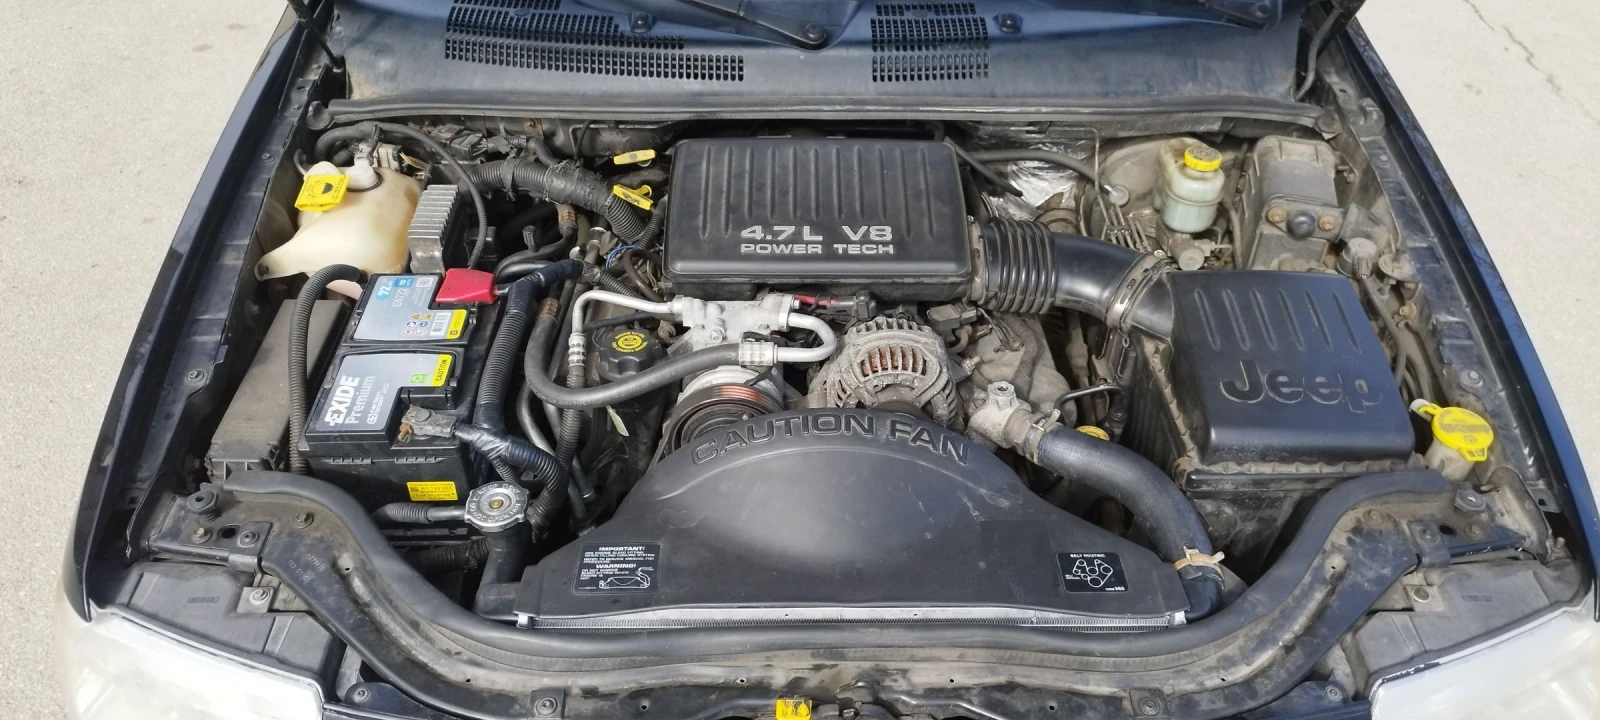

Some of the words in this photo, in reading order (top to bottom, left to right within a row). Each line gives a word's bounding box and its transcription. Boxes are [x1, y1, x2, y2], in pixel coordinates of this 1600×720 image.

[740, 225, 796, 240] 4.7
[803, 226, 822, 240] L
[842, 226, 892, 240] V8
[740, 244, 822, 254] POWER
[834, 244, 894, 254] TECH
[436, 359, 448, 382] CAUTION
[1219, 360, 1383, 414] Jeep
[324, 376, 360, 427] EXIDE
[344, 376, 376, 424] Premium
[692, 414, 876, 466] CAUTION
[888, 419, 970, 466] FAN
